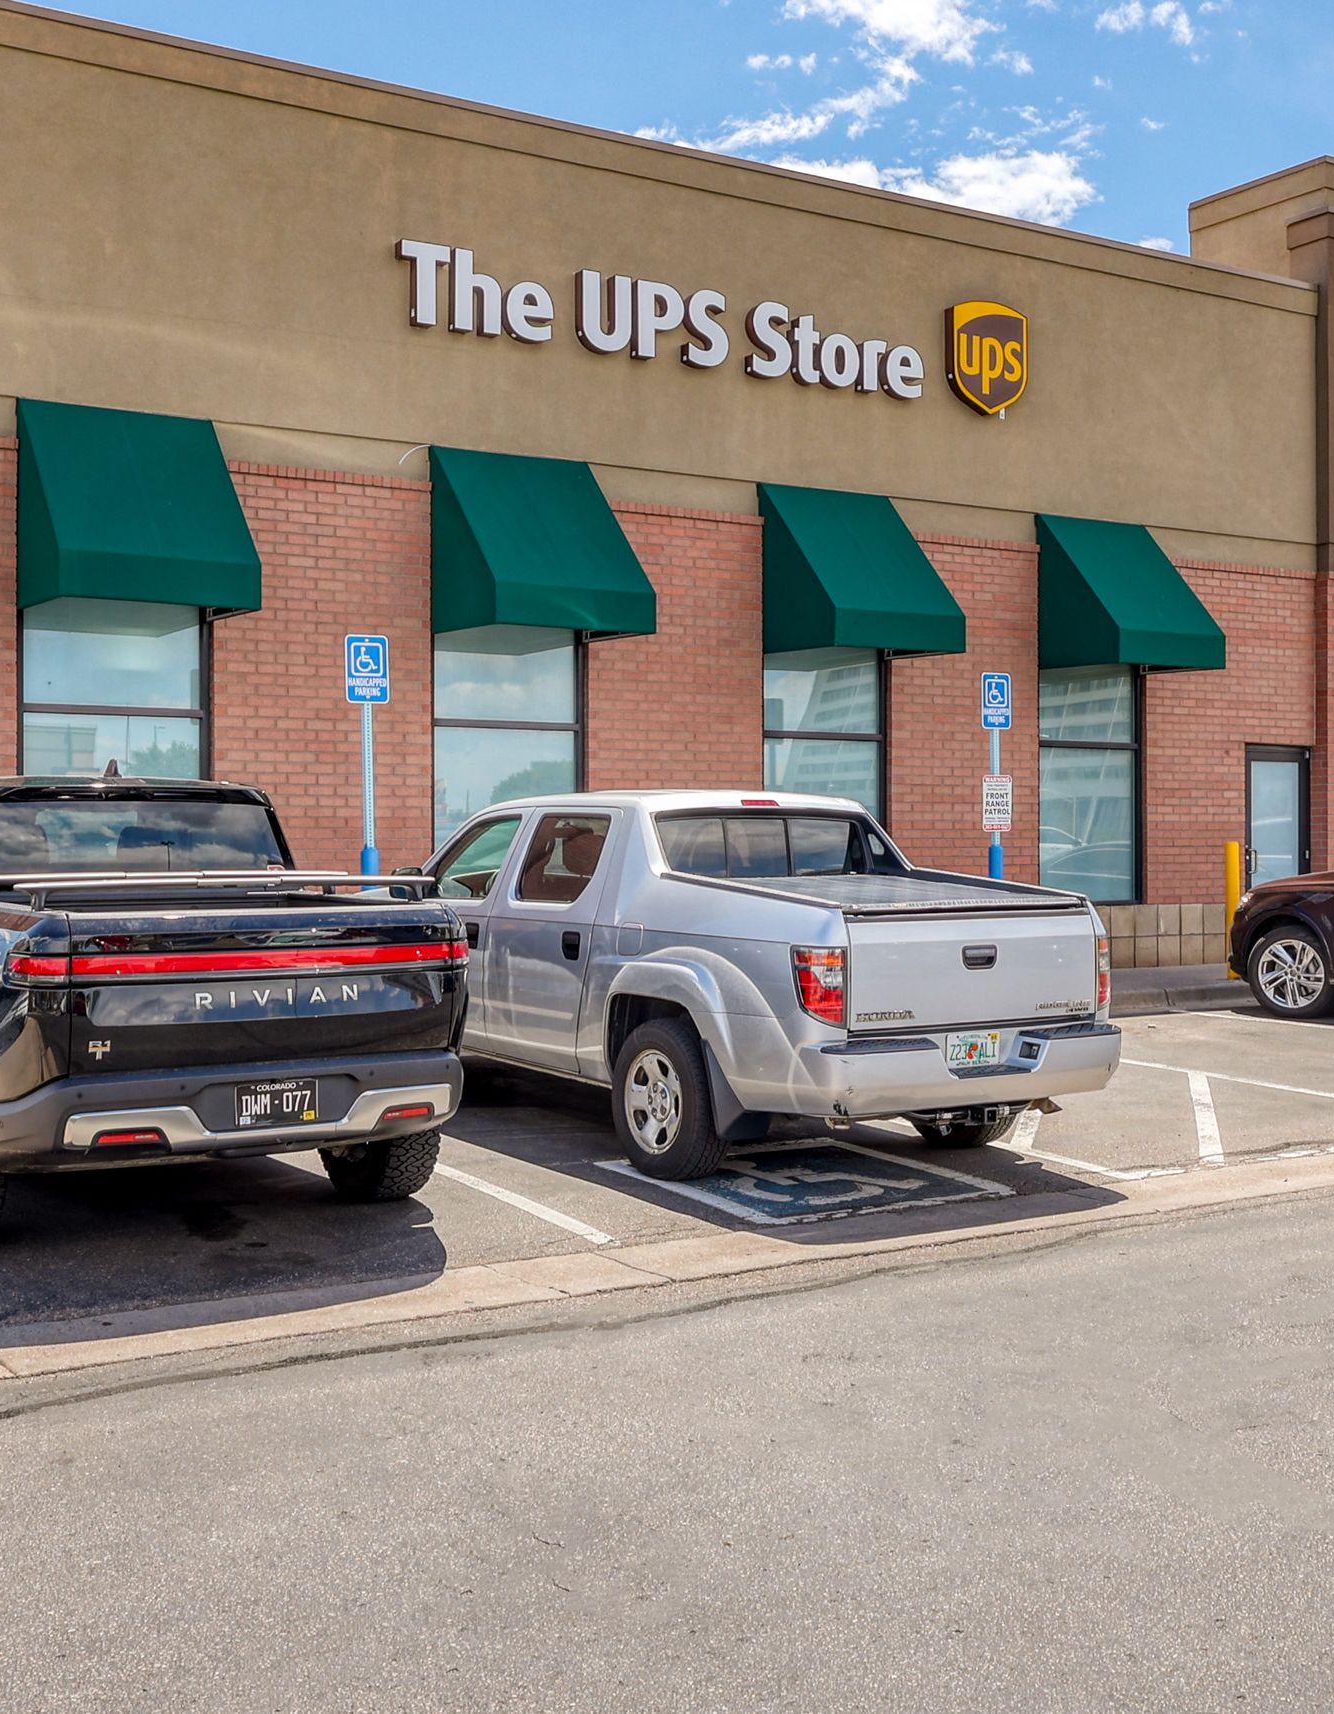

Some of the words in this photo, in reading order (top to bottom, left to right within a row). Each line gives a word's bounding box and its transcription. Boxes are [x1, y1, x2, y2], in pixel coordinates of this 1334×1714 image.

[397, 238, 555, 344] The
[574, 268, 730, 368] UPS
[745, 300, 925, 399] Store
[960, 333, 1022, 395] ups
[348, 677, 387, 687] HANDICAPPED
[355, 687, 380, 696] PARKING
[985, 792, 1009, 800] FRONT
[985, 800, 1010, 808] RANGE
[984, 808, 1010, 816] PATROL
[195, 984, 359, 1010] RIVIAN
[256, 1082, 297, 1092] COLORADO
